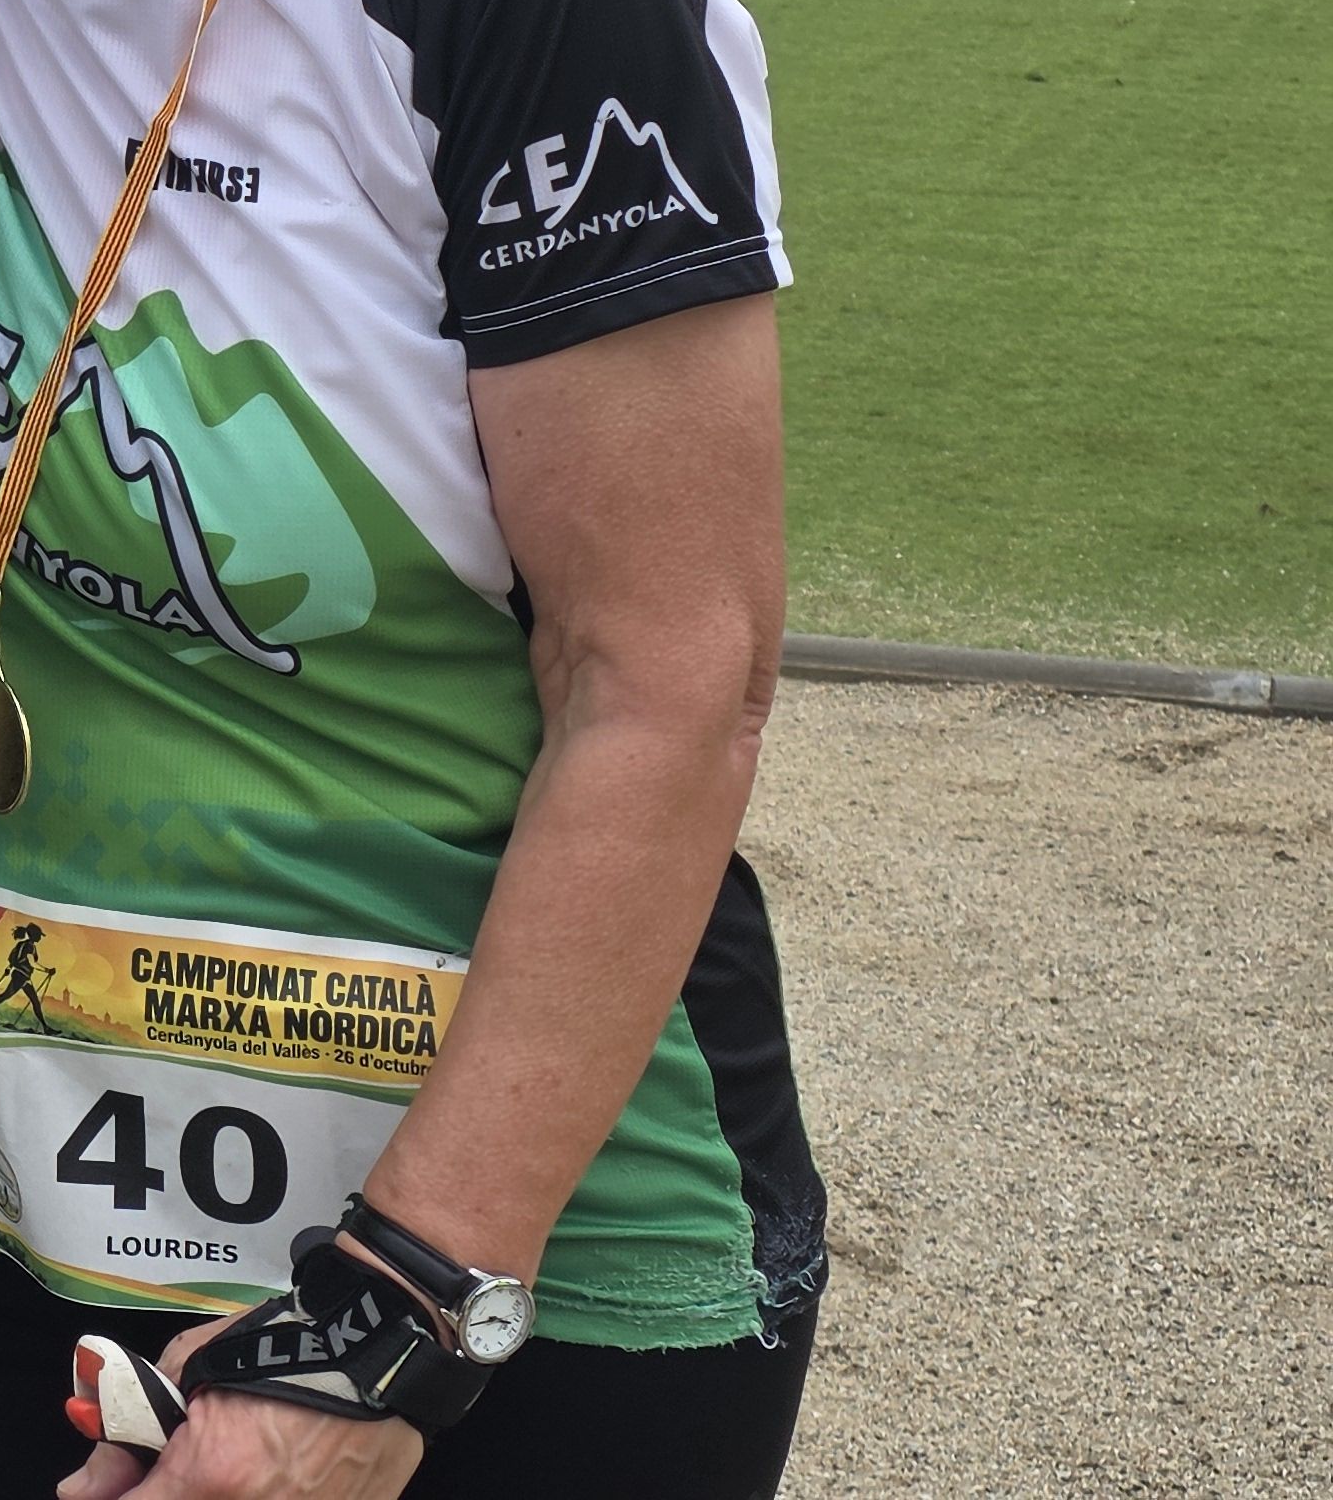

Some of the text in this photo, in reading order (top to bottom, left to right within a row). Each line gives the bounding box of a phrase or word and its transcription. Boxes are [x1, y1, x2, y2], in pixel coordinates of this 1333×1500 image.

[479, 194, 686, 271] CERDANYOLA
[131, 947, 436, 1016] CAMPIONAT CATALÀ
[144, 988, 437, 1057] MARXA NÒRDICA
[146, 1026, 237, 1052] Cerdanyola
[242, 1040, 267, 1056] del
[272, 1042, 320, 1059] Vallès
[334, 1049, 354, 1065] 26
[55, 1088, 288, 1225] 40
[106, 1235, 239, 1264] LOURDES
[257, 1290, 382, 1367] LEKI
